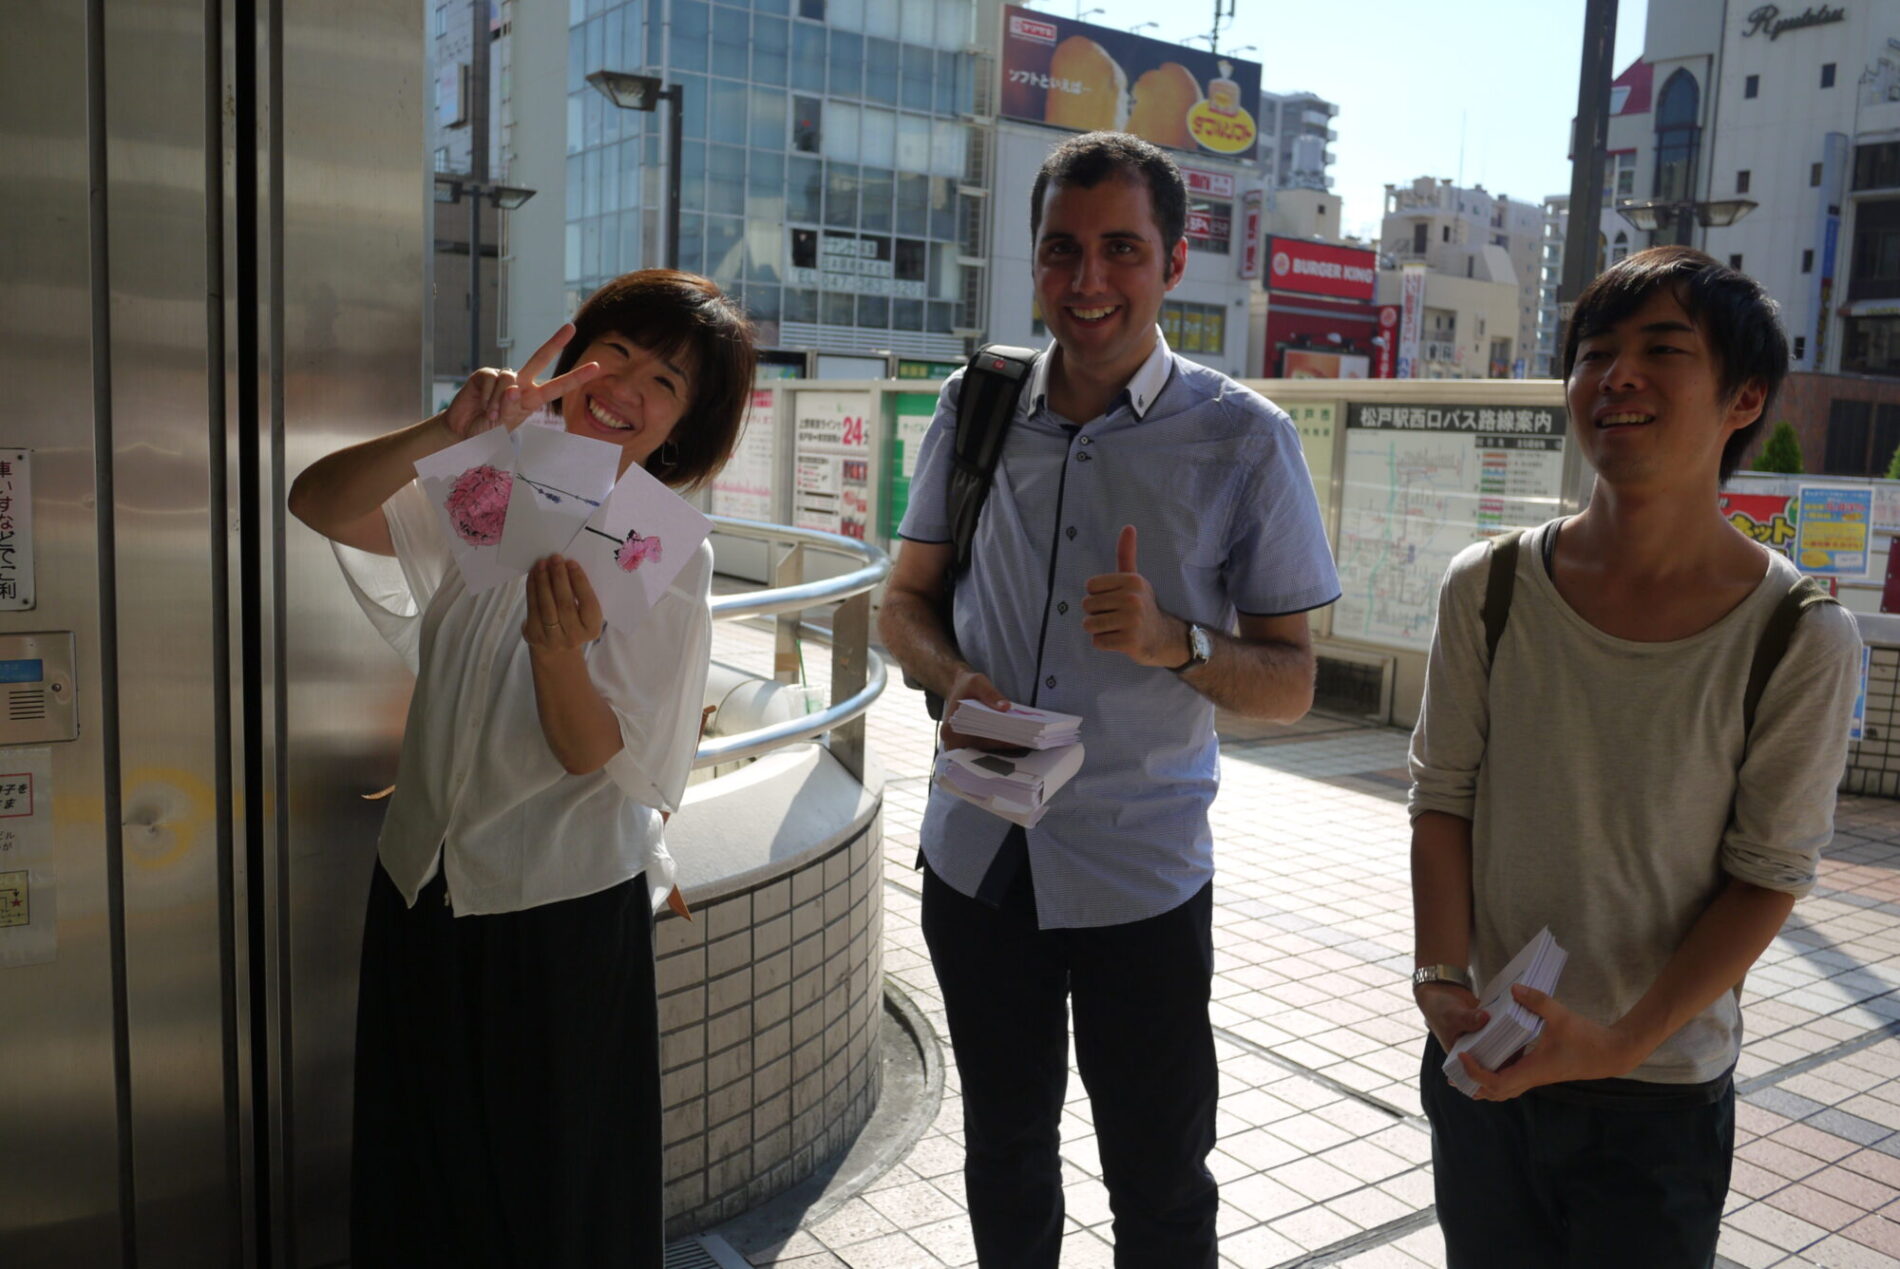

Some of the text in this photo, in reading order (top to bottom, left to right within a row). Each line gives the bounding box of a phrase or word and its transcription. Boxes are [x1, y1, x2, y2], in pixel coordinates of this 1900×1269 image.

[1293, 258, 1373, 283] BURGER KING
[843, 416, 863, 446] 24
[1361, 407, 1552, 433] 松戸駅西口バス路線案内
